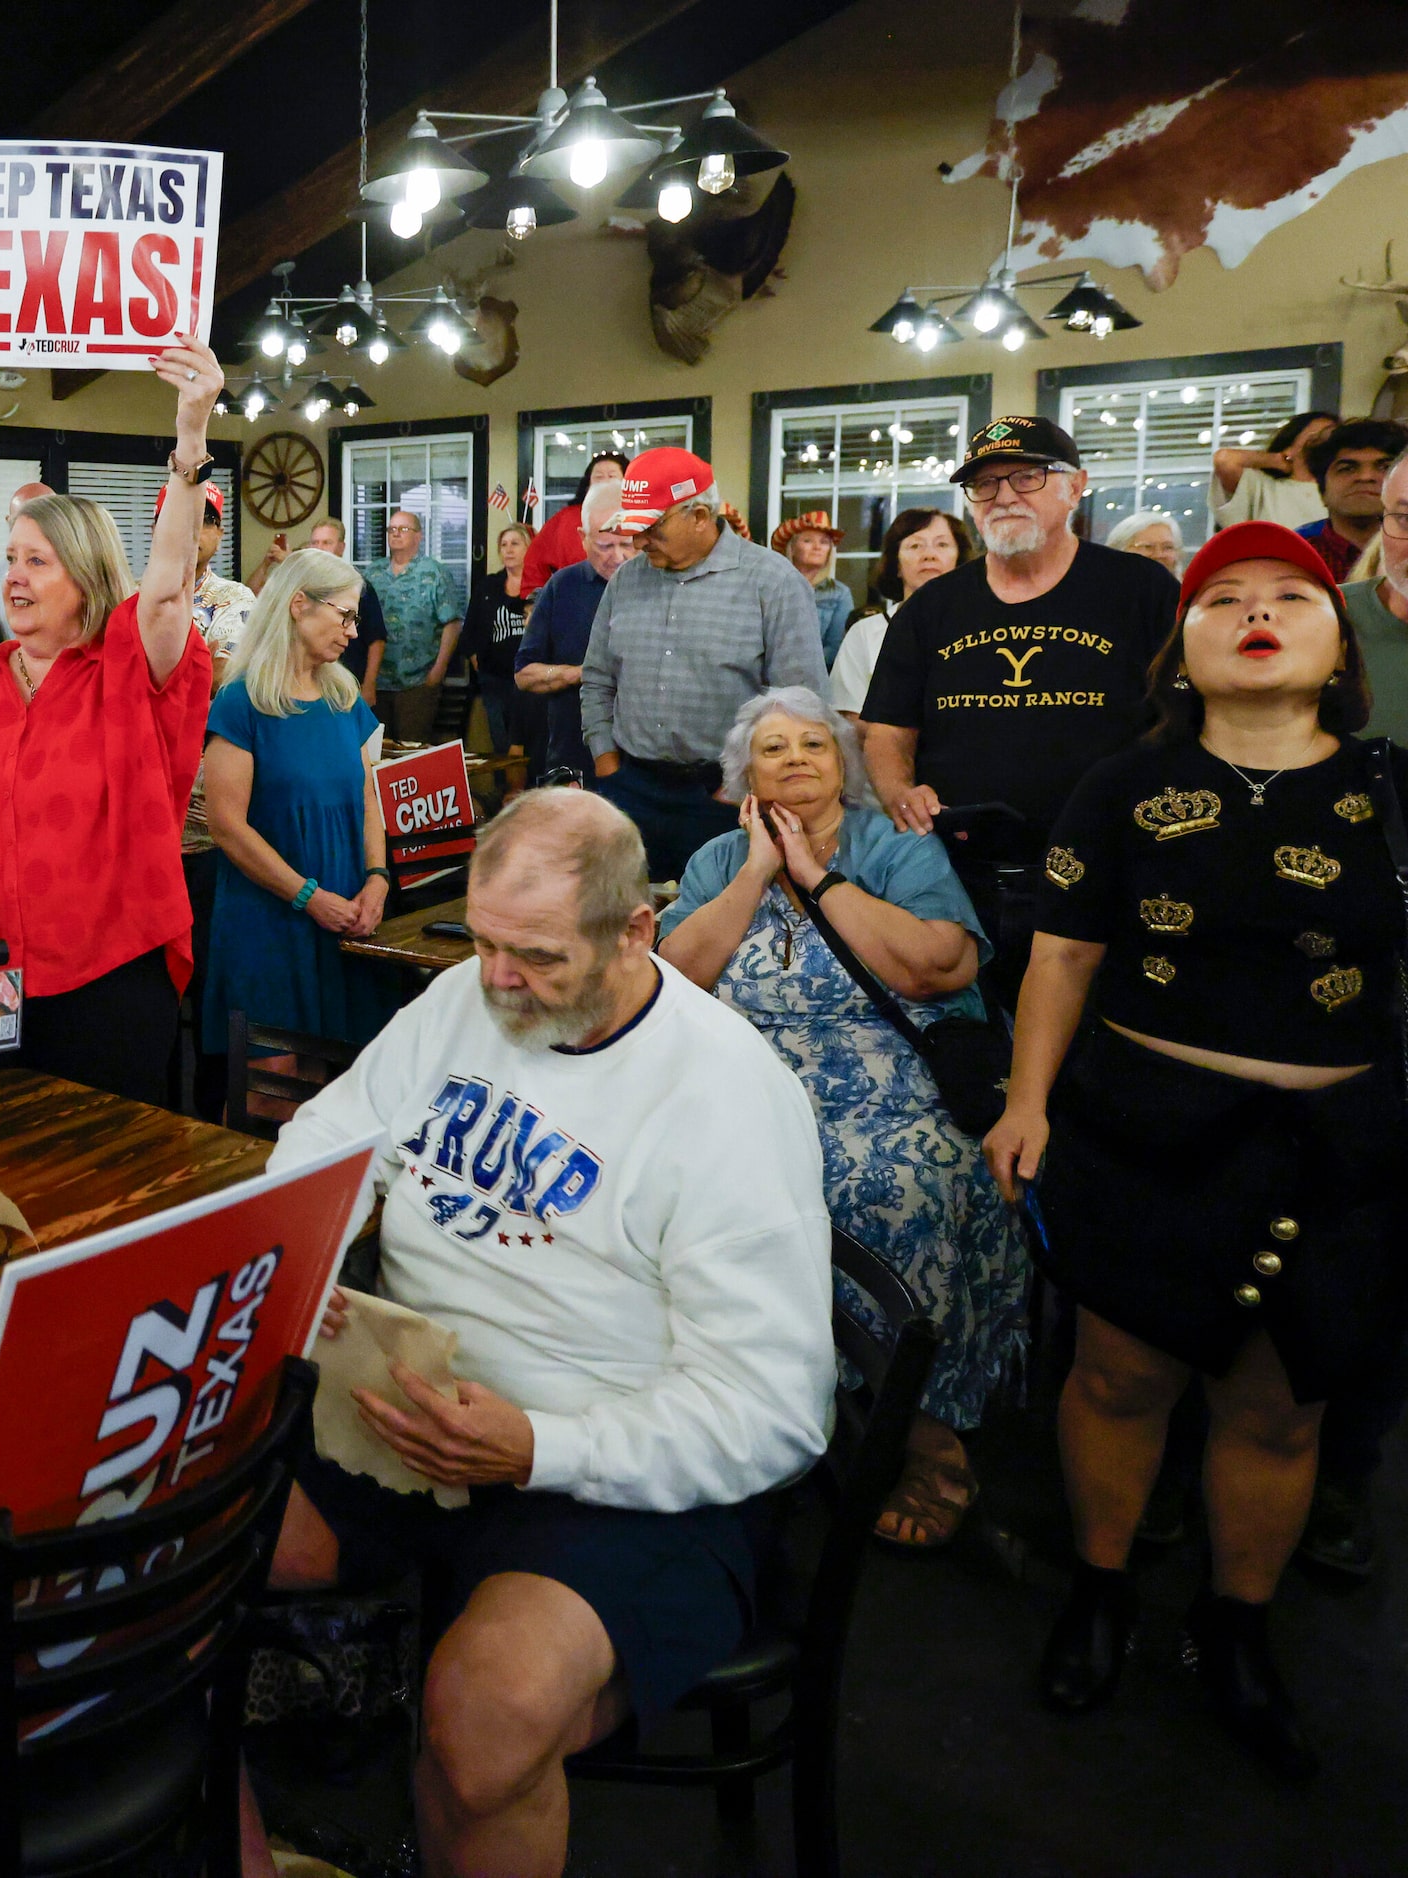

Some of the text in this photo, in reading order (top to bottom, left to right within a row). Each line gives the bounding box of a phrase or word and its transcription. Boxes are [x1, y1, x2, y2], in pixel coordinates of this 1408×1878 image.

[45, 162, 186, 225] TEXAS
[977, 439, 1021, 457] DIVISION
[621, 478, 649, 493] UMP
[937, 625, 1114, 661] YELLOWSTONE
[936, 691, 1105, 710] DUTTON RANCH
[389, 776, 418, 801] TED
[395, 785, 460, 834] CRUZ
[395, 1073, 606, 1226] TRUMP
[425, 1191, 502, 1243] 47
[167, 1246, 284, 1488] TEXAS
